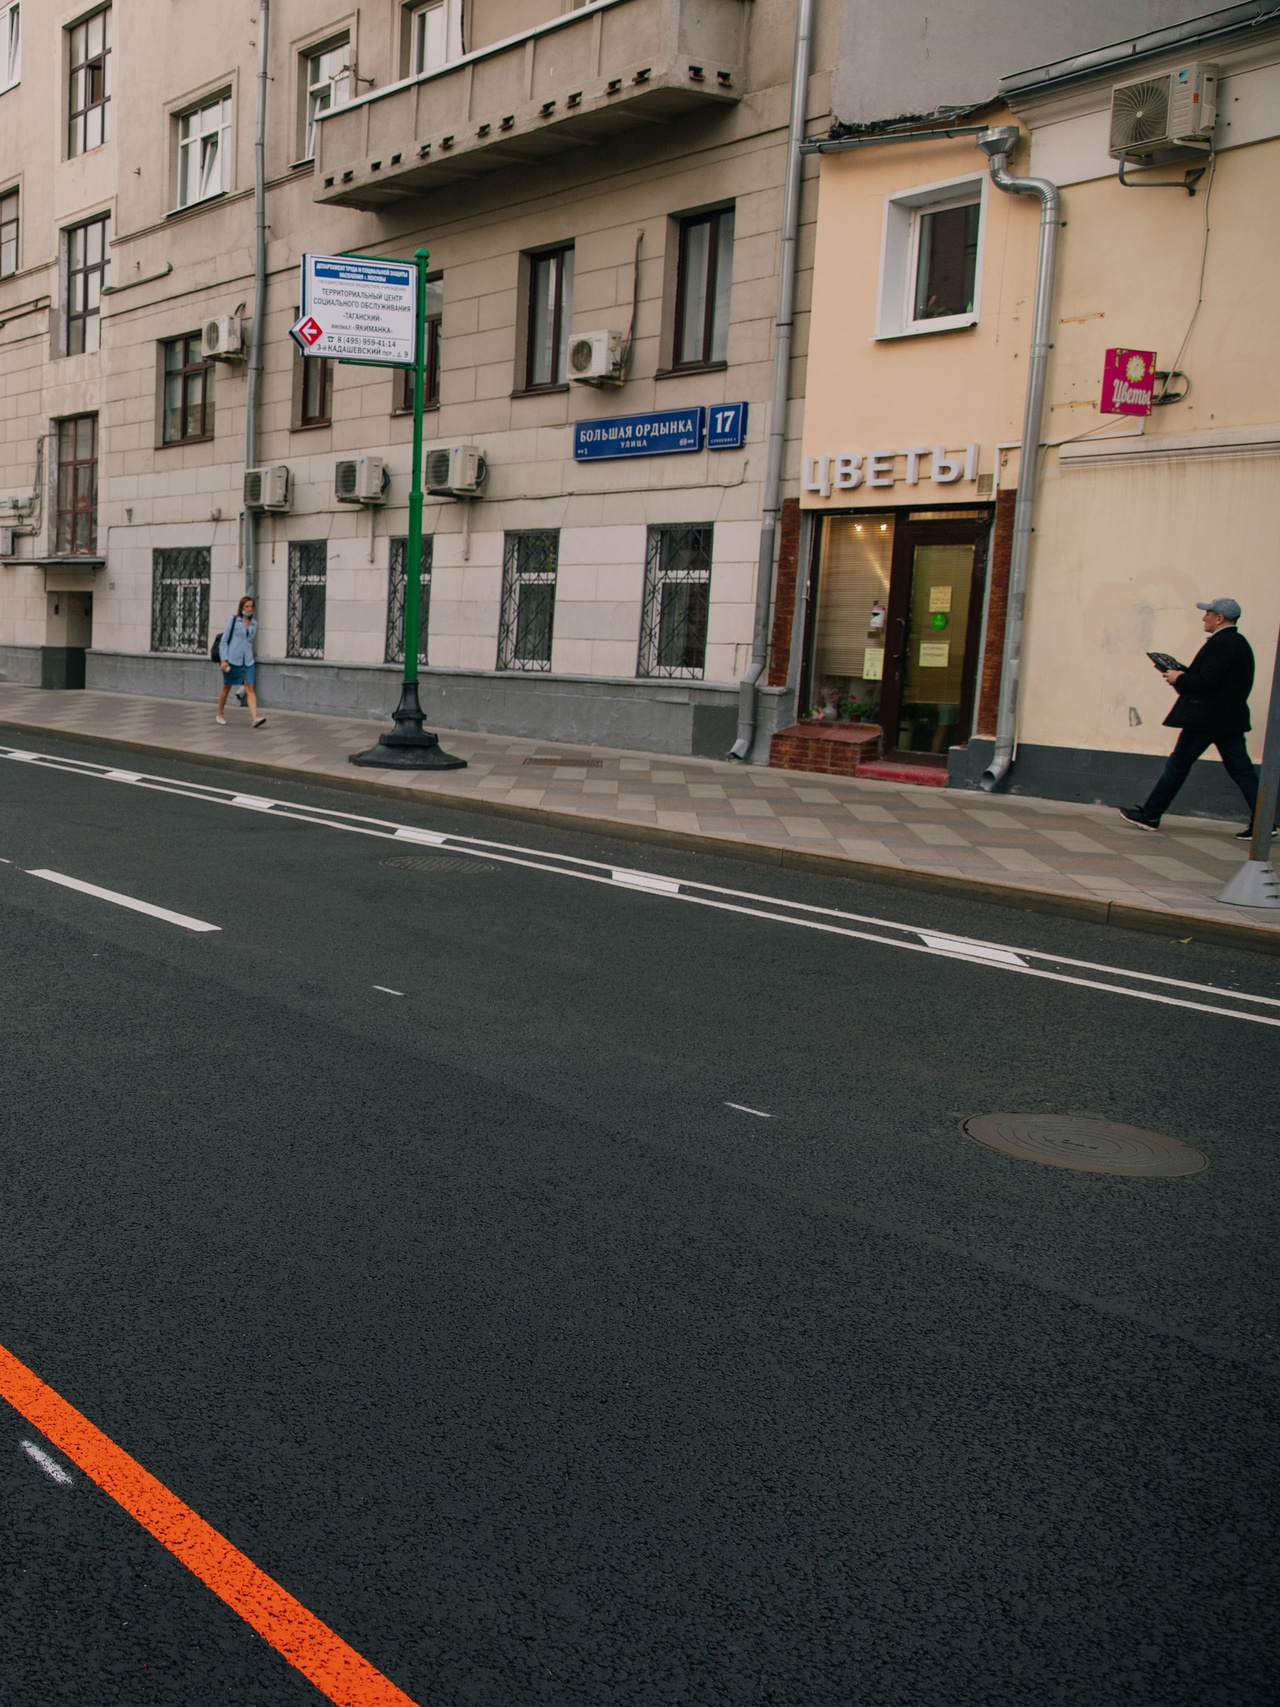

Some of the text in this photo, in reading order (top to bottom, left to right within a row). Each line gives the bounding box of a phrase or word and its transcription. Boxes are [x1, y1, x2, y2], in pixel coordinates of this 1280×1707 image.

[322, 288, 403, 302] ТЕРРИТОРИАЛЬНЫЙ ЦЕНТР
[313, 297, 411, 312] СОЦИАЛЬНОГО ОБСЛУЖИВАНИЯ
[343, 336, 362, 345] (495)
[363, 338, 396, 347] 959-41-14
[328, 345, 381, 356] КАДАШЕВСКИЙ
[1112, 379, 1151, 408] Цветы
[715, 410, 735, 433] 17
[580, 419, 693, 443] БОЛЬШАЯ ОРДЫНКА
[620, 439, 647, 448] УЛИЦА
[803, 443, 980, 497] ЦВЕТЫ
